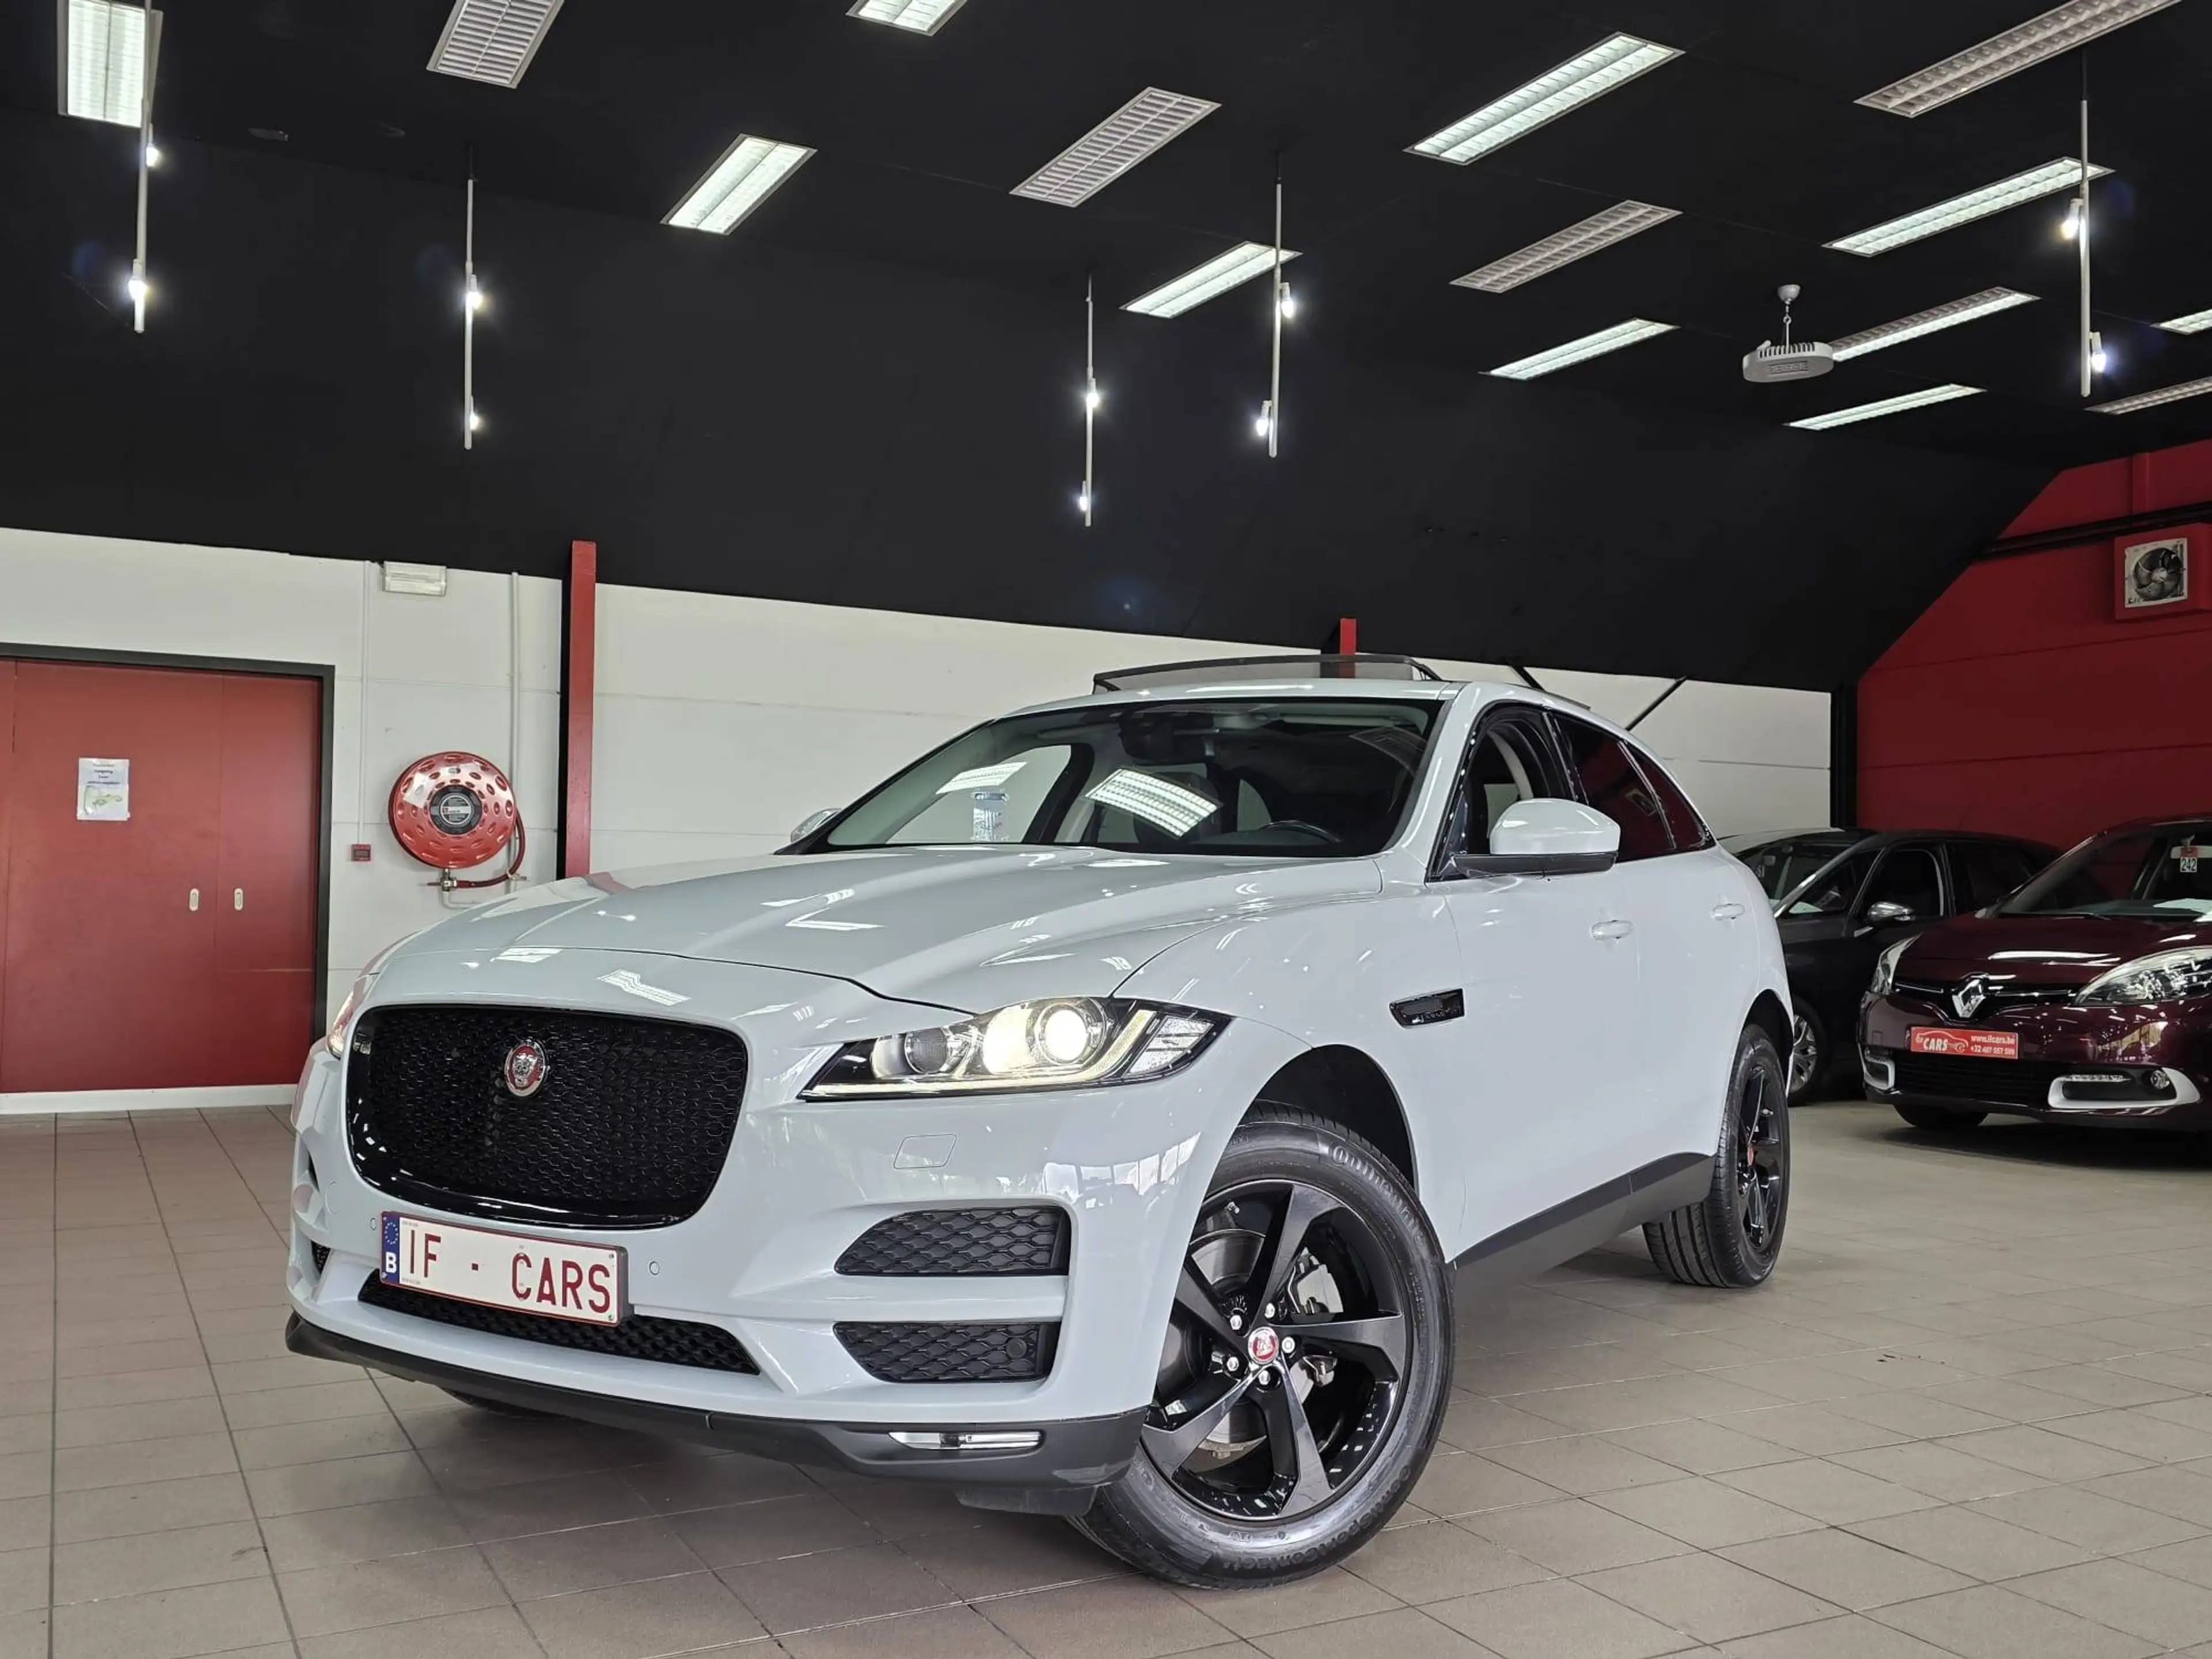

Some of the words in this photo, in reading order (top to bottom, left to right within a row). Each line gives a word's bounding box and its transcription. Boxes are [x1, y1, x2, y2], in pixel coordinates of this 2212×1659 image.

[2181, 858, 2196, 871] 242
[1923, 1037, 1948, 1051] CARS
[385, 1251, 397, 1274] B
[410, 1229, 441, 1278] IF
[512, 1252, 611, 1314] CARS
